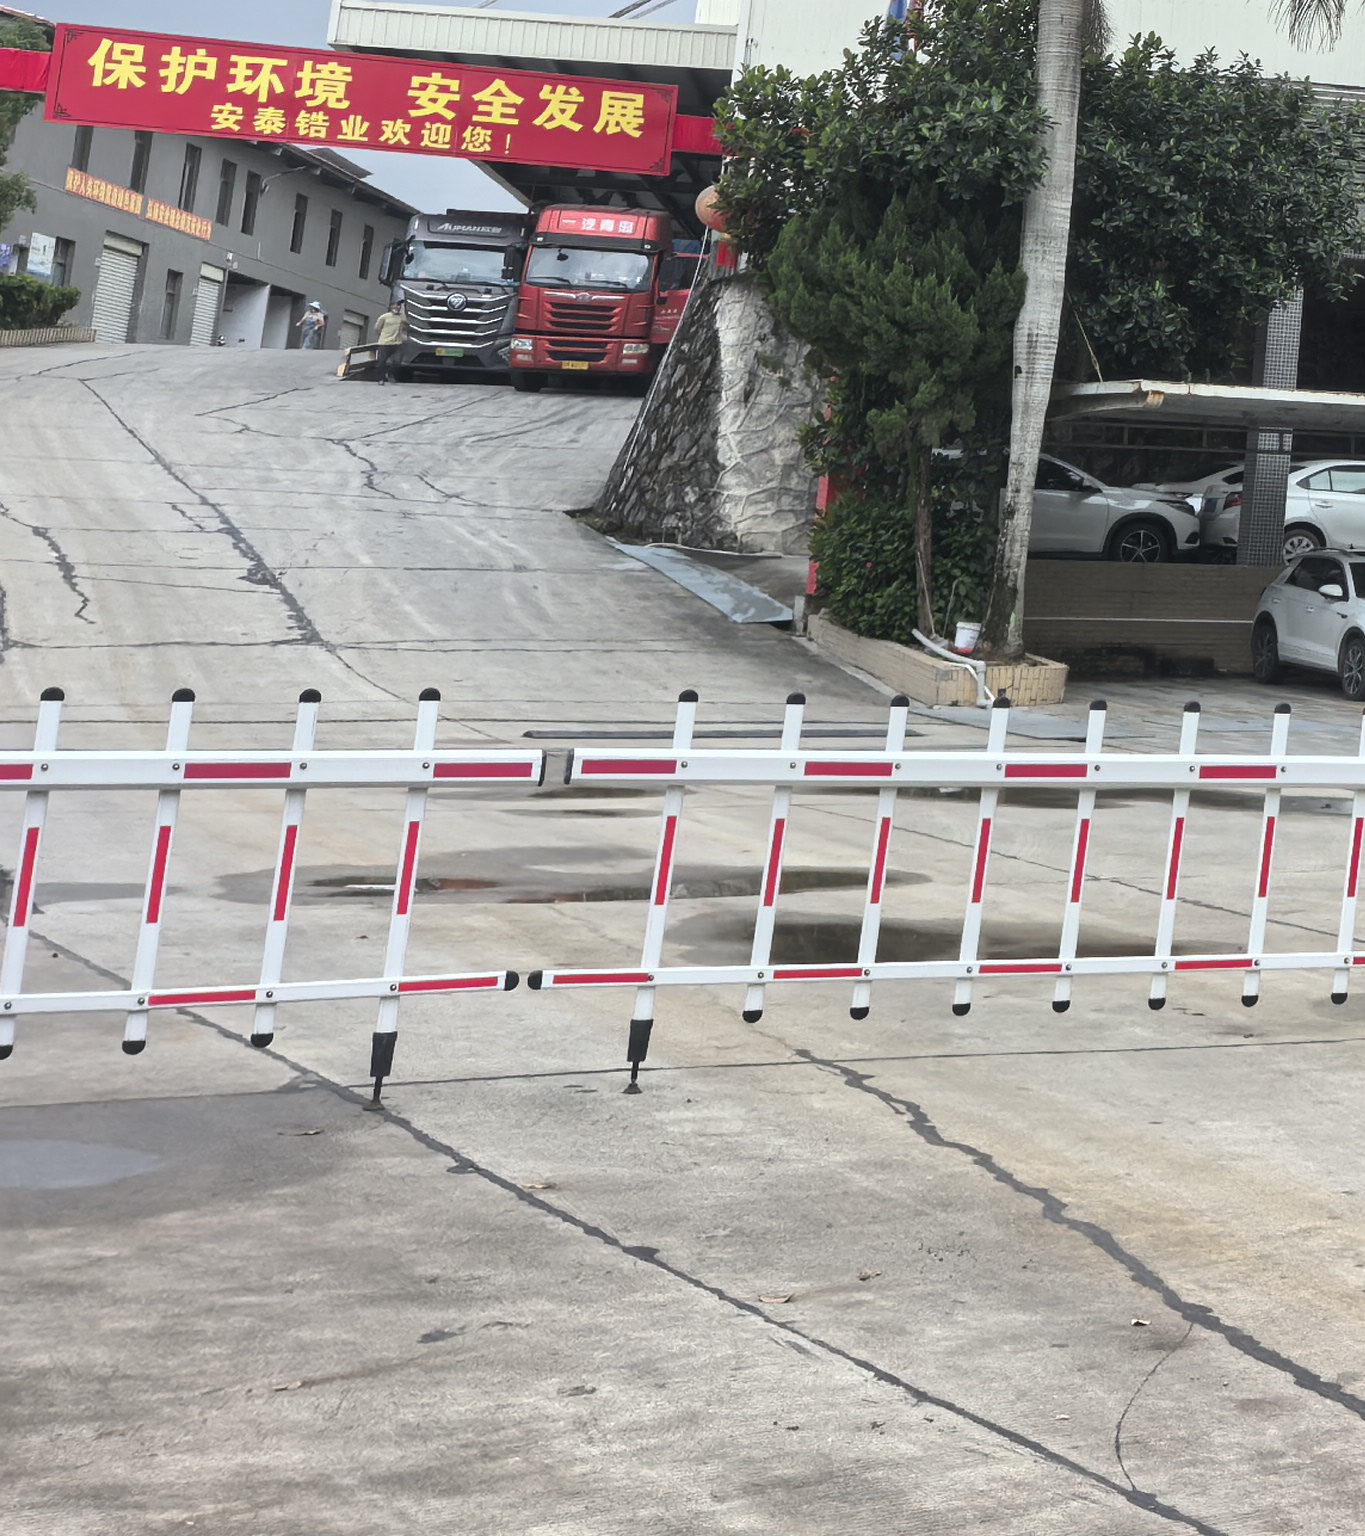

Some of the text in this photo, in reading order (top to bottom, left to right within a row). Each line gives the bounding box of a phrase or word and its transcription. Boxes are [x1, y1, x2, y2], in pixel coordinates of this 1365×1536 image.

[87, 37, 646, 139] 保护环境 安全发展
